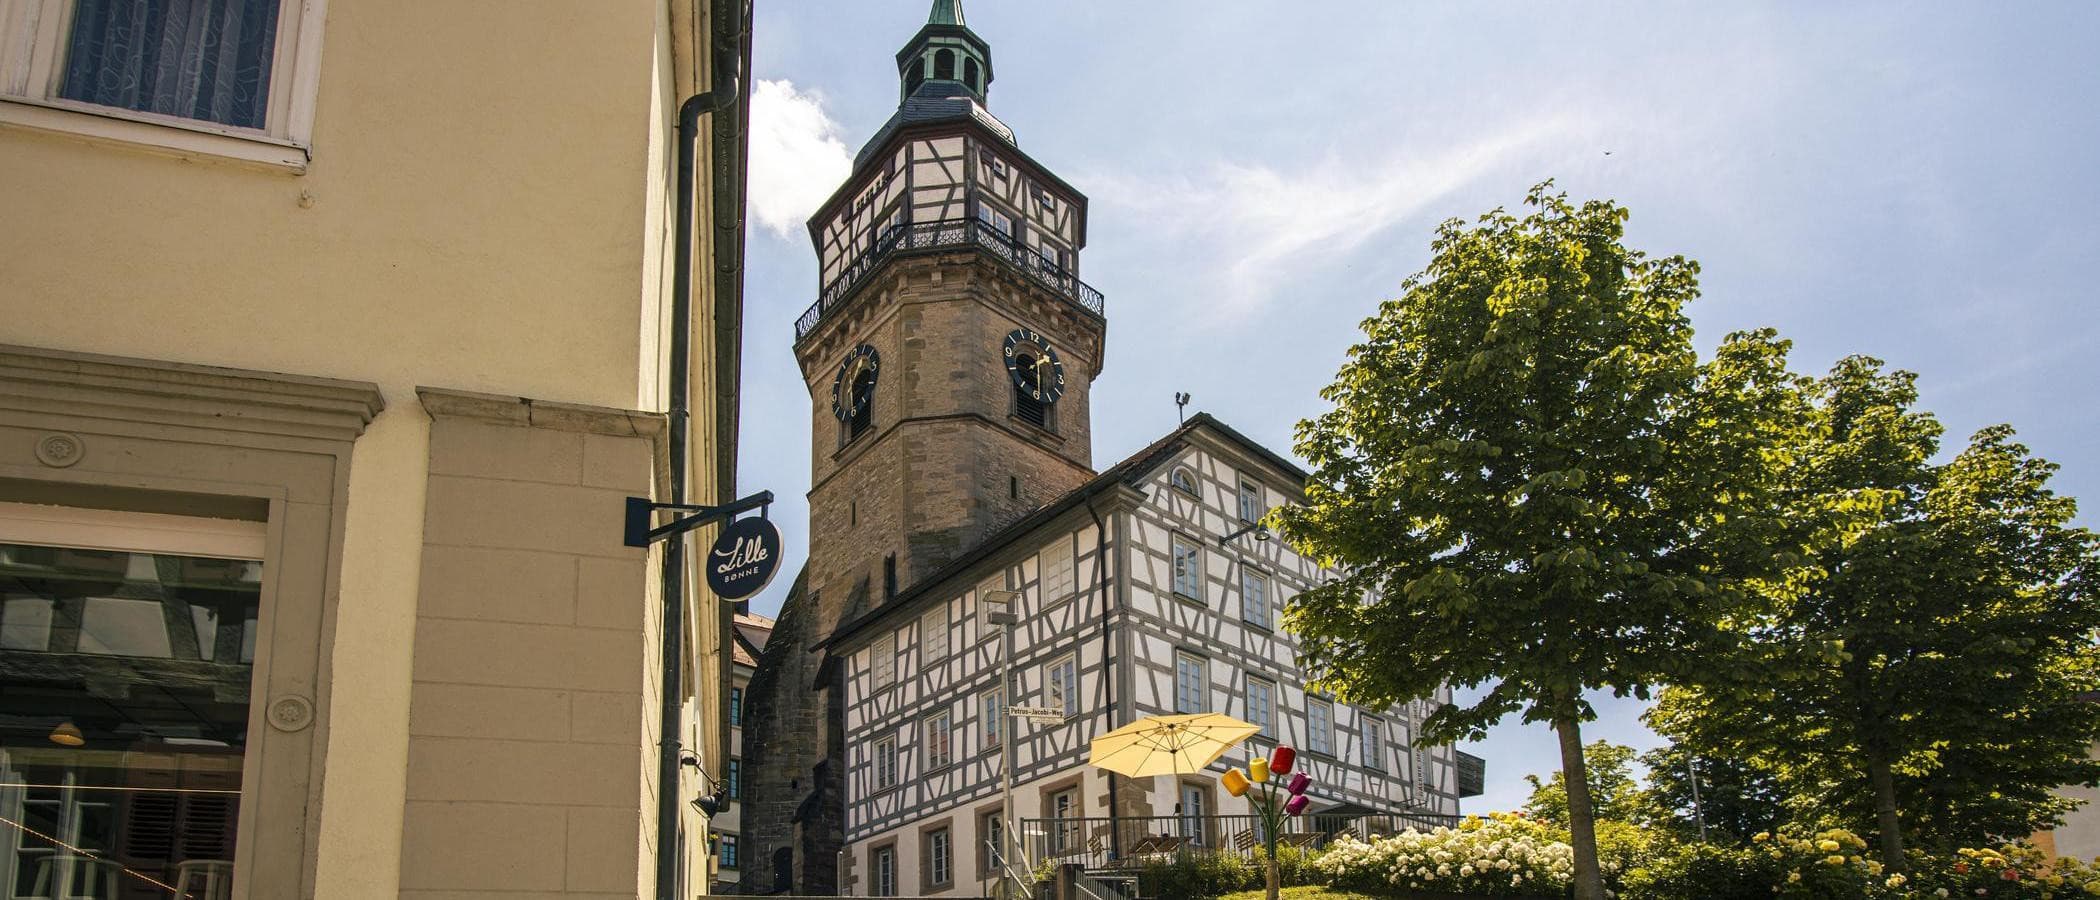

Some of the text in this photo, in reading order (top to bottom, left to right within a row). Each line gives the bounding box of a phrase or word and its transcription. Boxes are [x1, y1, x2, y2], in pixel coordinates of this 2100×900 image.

[1030, 331, 1040, 344] 12
[1005, 346, 1013, 357] 9
[872, 360, 877, 372] 3
[1057, 373, 1065, 385] 3
[1032, 390, 1040, 400] 6
[850, 406, 857, 417] 6
[714, 535, 768, 574] Lille
[1011, 707, 1063, 716] Petrus-Jacobi-Weg
